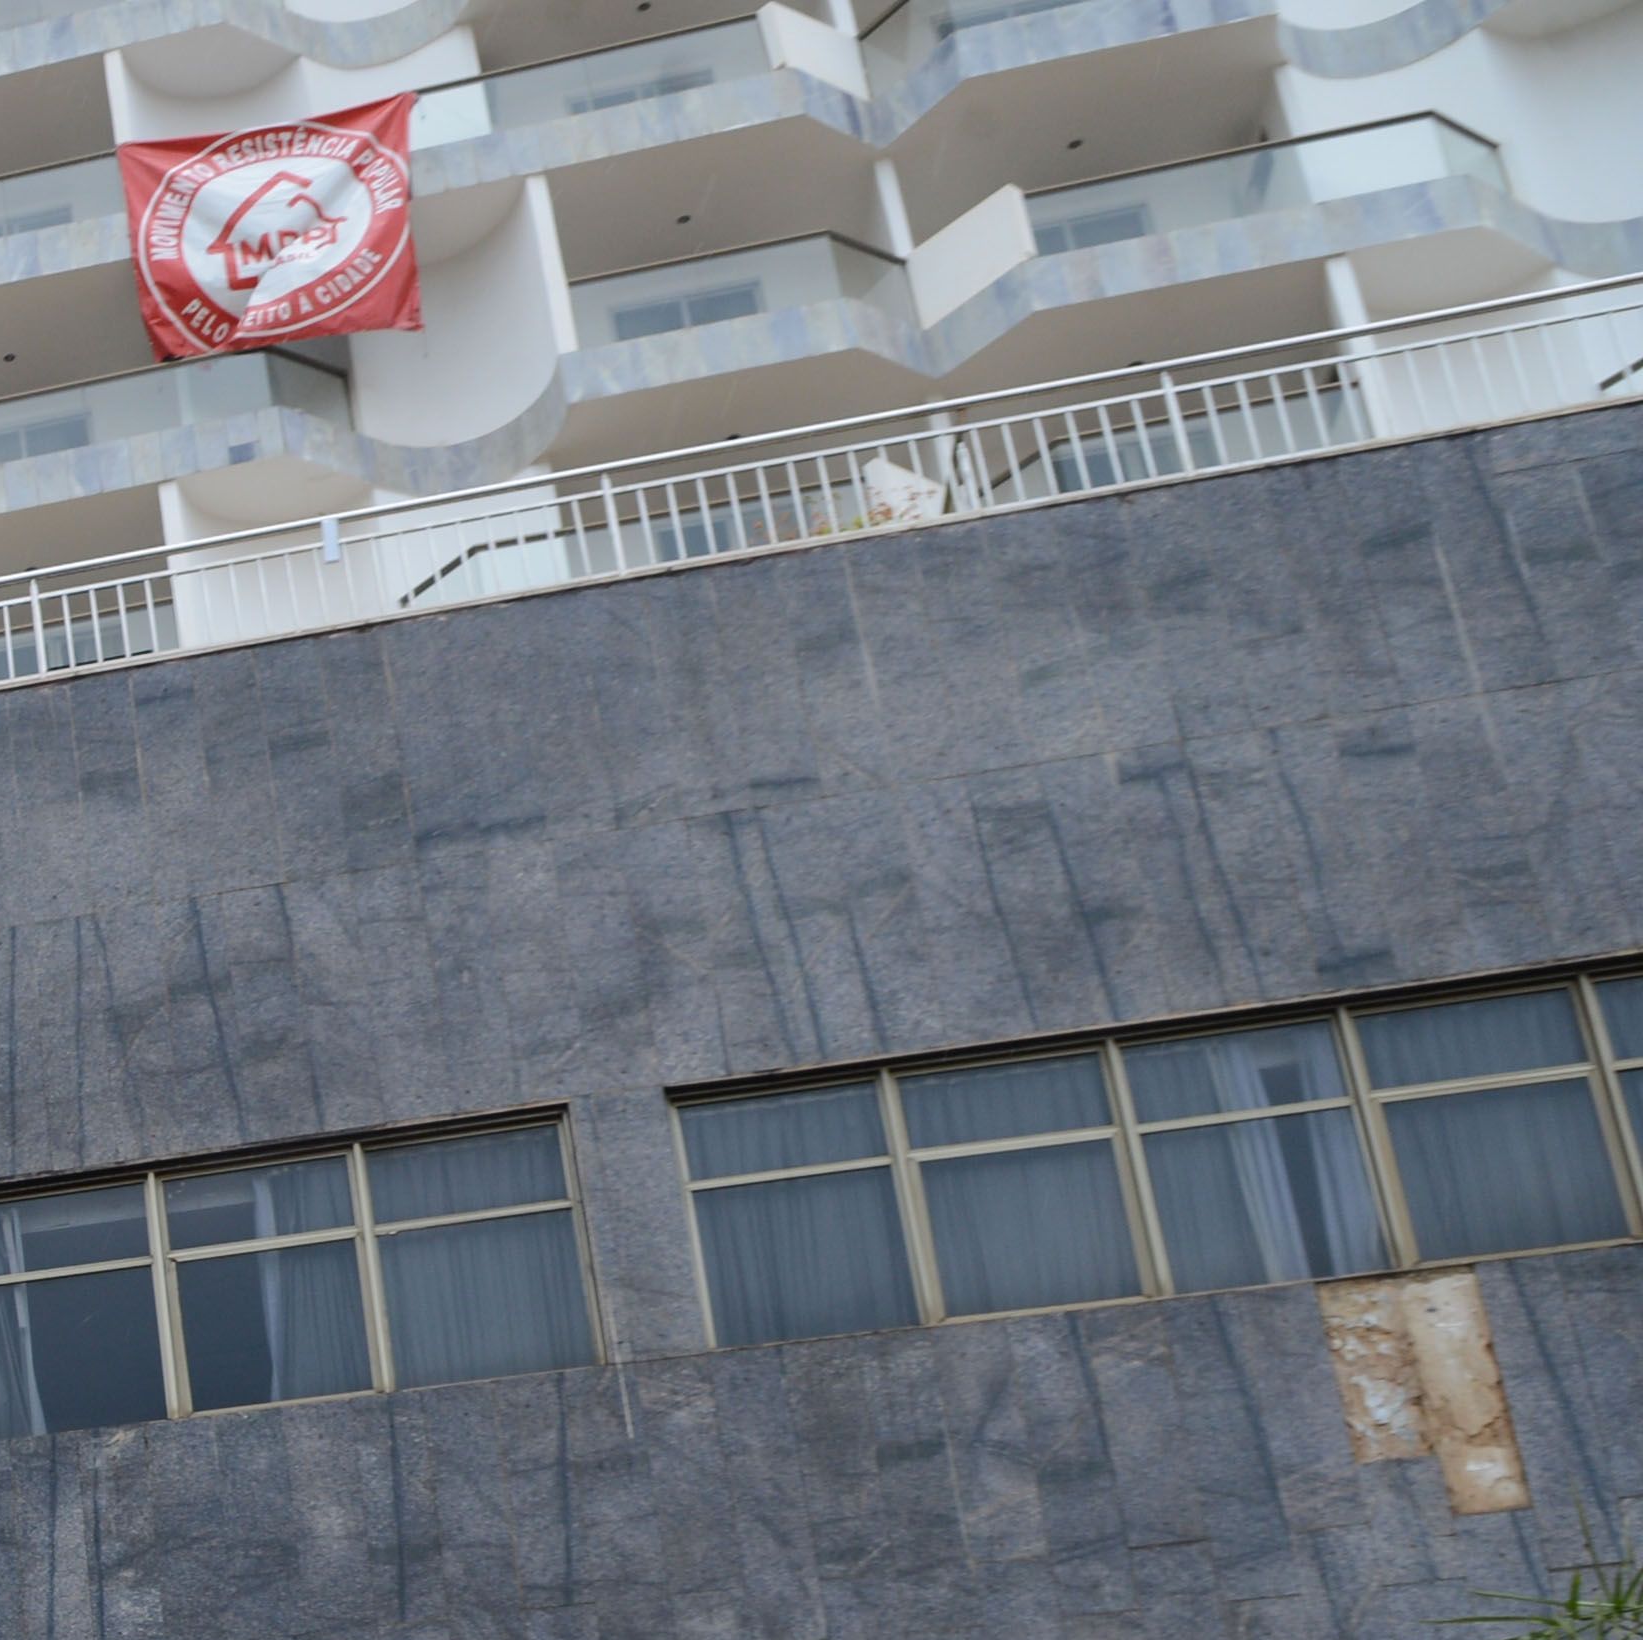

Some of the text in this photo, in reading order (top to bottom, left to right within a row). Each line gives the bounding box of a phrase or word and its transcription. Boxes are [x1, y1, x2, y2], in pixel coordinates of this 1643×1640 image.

[150, 126, 404, 261] MOVIMENTO RESISTÊNCIA POPULAR
[181, 298, 230, 343] PELO
[315, 248, 383, 304] CIDADE
